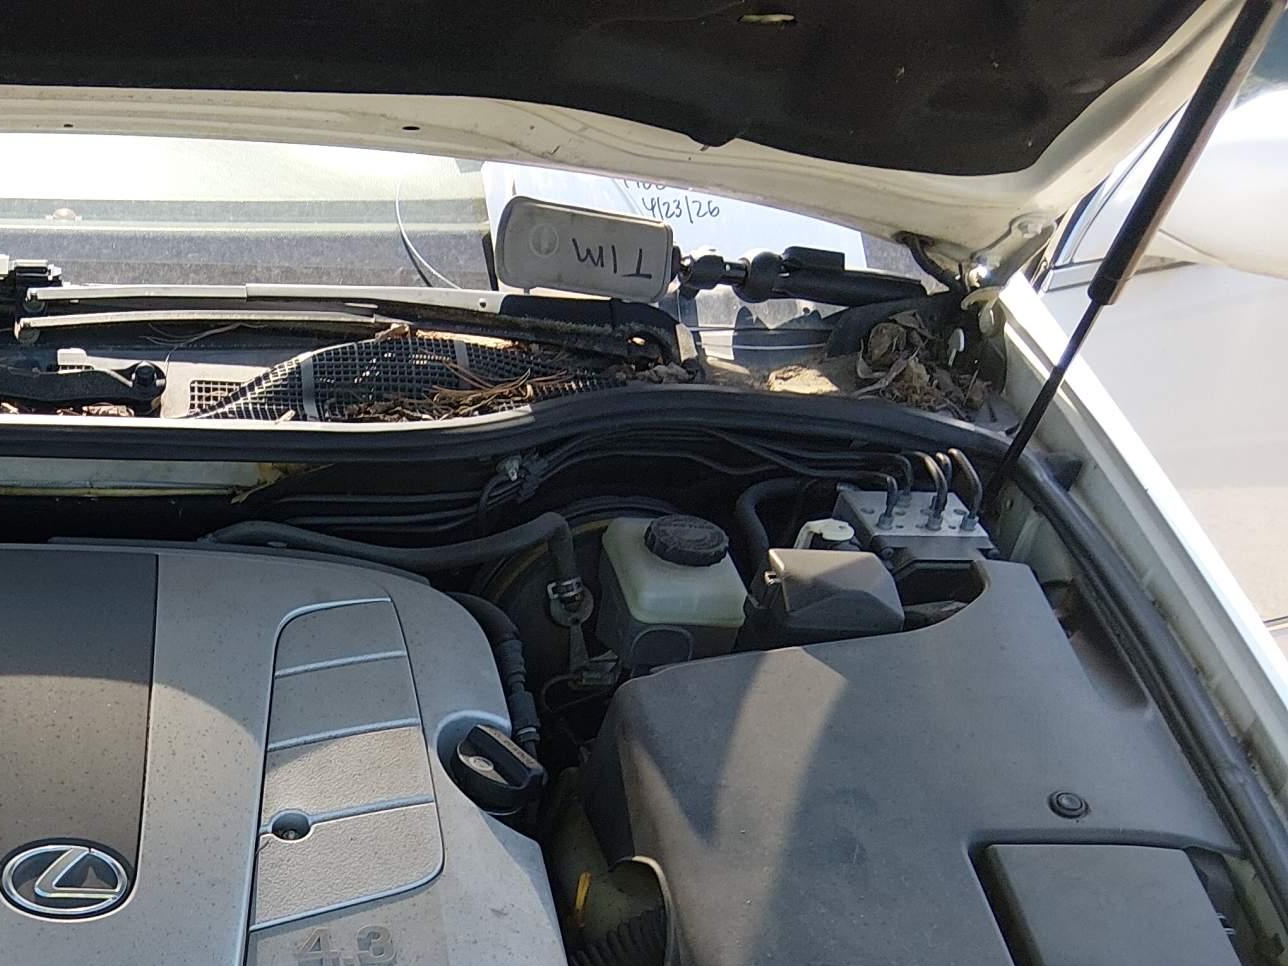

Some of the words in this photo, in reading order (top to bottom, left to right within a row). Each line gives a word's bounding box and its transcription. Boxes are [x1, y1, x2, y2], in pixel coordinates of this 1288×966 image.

[641, 194, 721, 224] 4/23/26
[571, 238, 652, 280] TIM
[294, 924, 397, 966] 4.3
